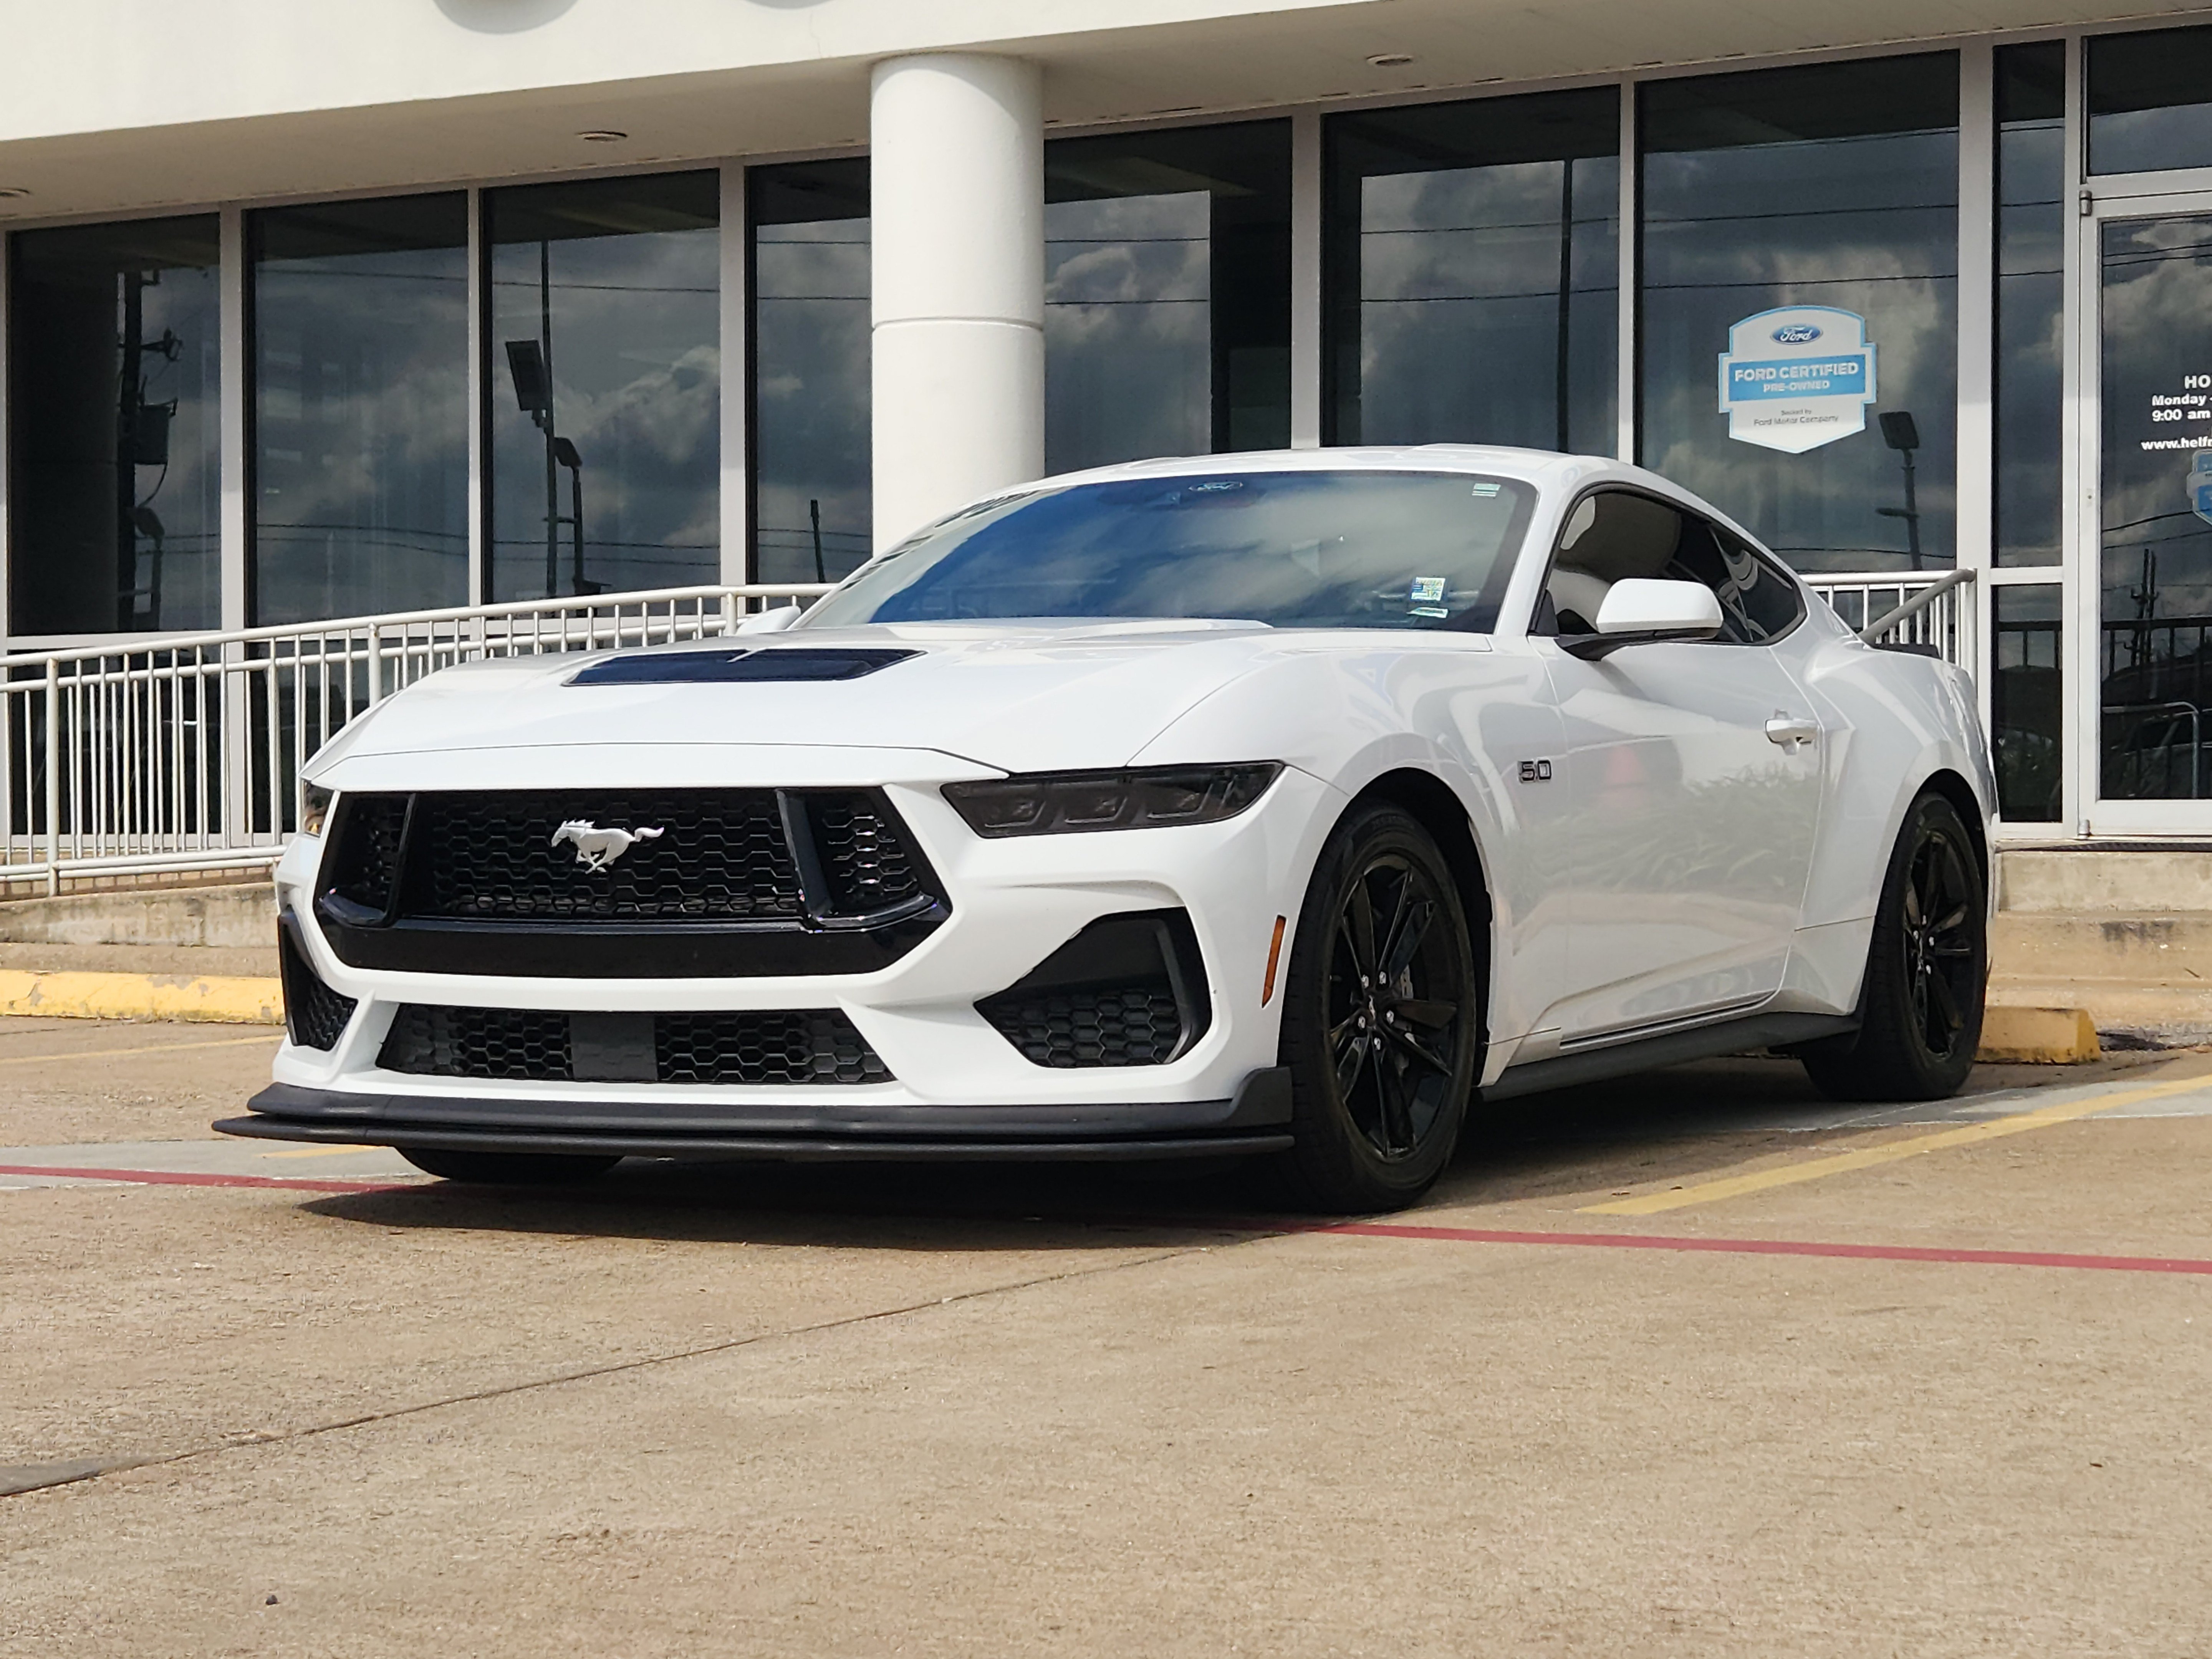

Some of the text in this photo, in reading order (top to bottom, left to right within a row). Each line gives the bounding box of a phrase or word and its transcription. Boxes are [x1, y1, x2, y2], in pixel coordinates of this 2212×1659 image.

[1780, 326, 1812, 341] Ford
[1735, 363, 1859, 382] FORD CERTIFIED
[1763, 381, 1830, 392] PRE-OWNED
[2184, 374, 2212, 389] HO
[2152, 393, 2207, 406] Monday
[2152, 409, 2211, 422] 9:00 am
